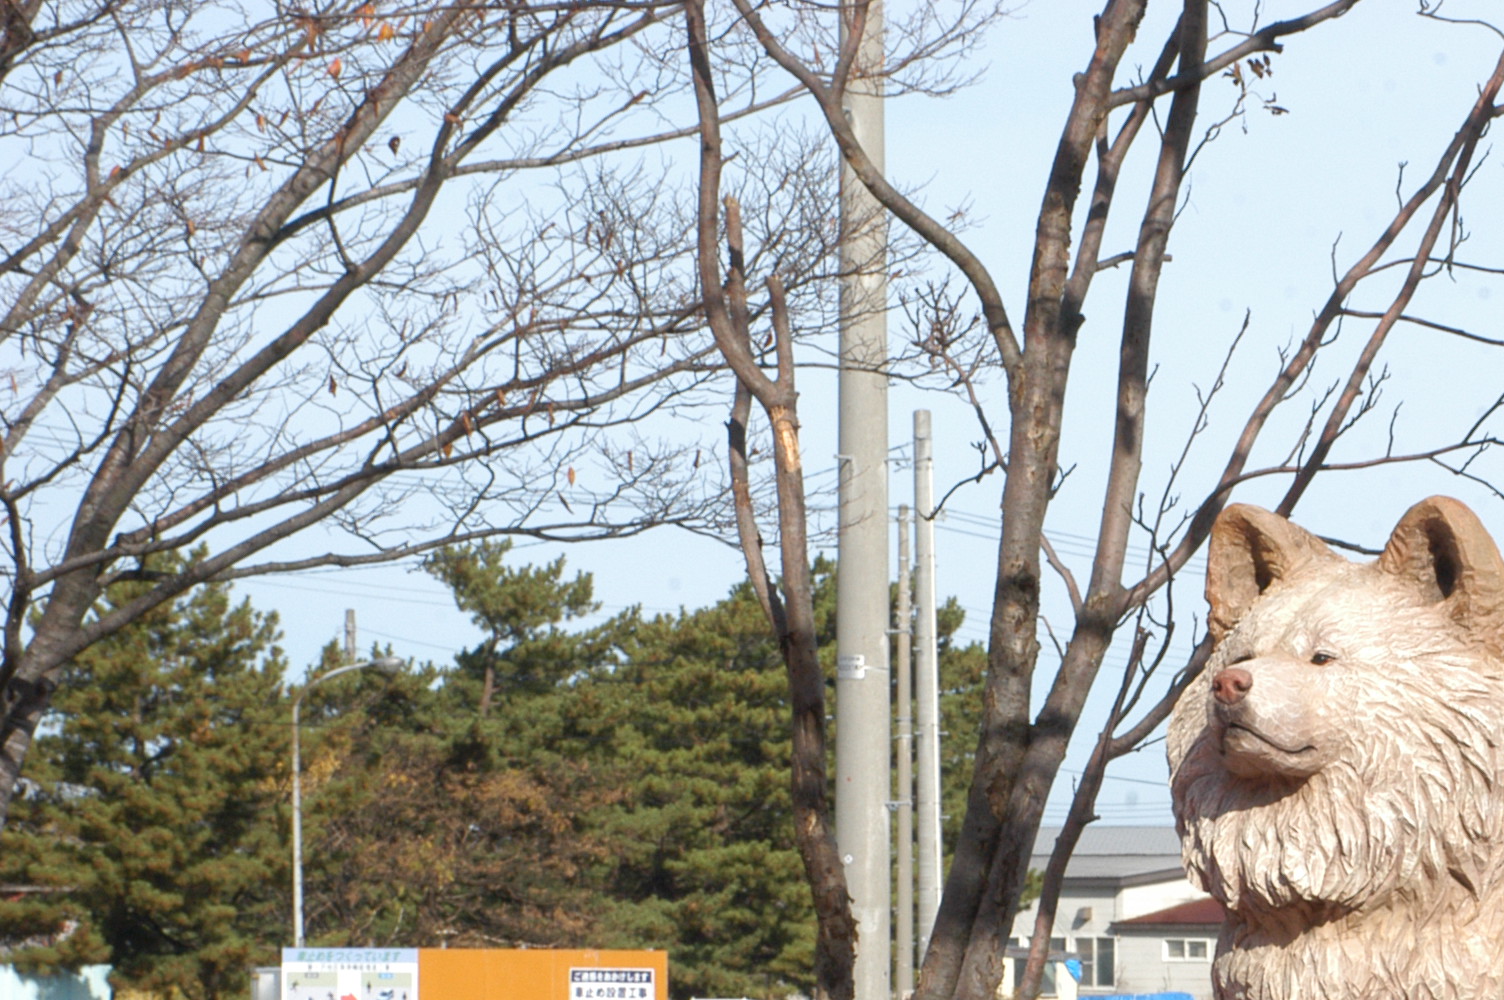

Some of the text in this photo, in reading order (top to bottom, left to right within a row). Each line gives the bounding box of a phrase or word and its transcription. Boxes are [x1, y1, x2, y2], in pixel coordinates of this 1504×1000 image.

[576, 986, 647, 998] 車止め設置工事
